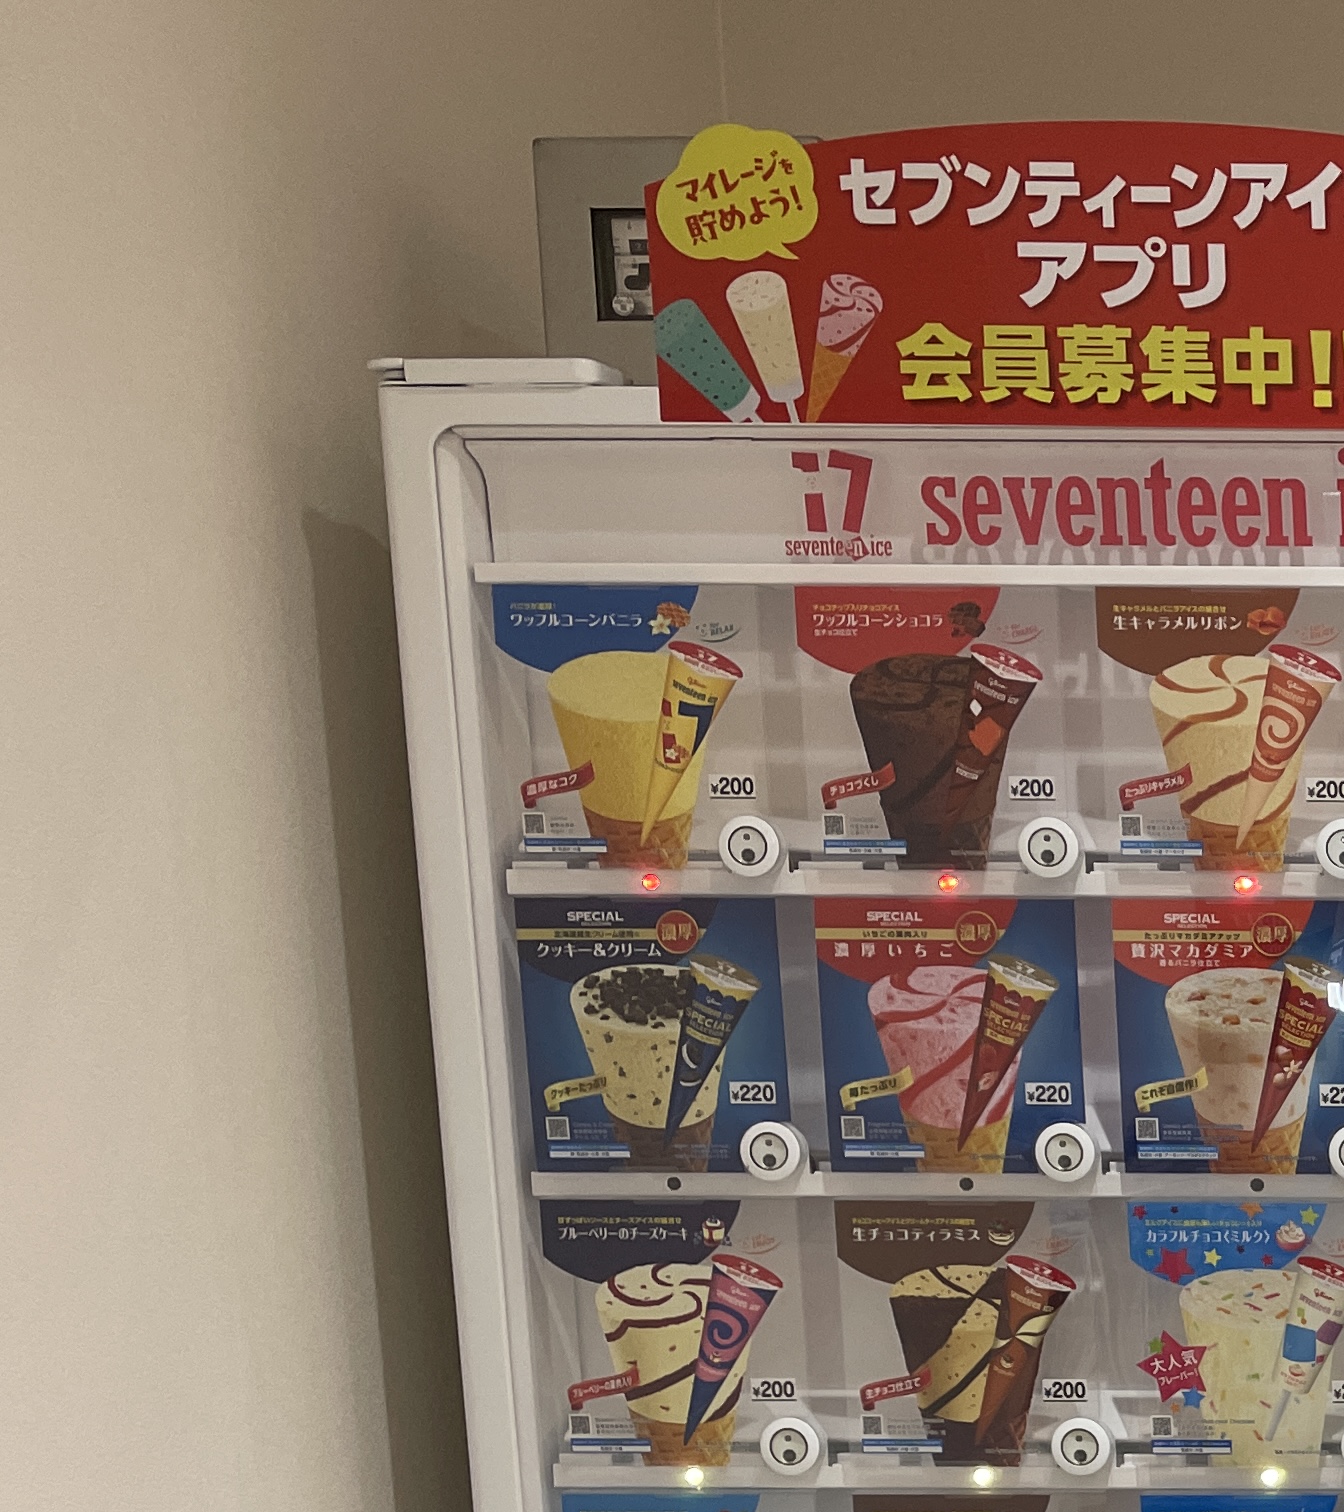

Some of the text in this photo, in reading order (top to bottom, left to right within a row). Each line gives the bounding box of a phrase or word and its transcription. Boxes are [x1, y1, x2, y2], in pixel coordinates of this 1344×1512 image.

[674, 157, 796, 207] マイレージを
[1017, 238, 1228, 308] アプリ
[921, 458, 1314, 549] seventeen
[510, 613, 643, 629] ワッフルコーンバニラ
[813, 613, 943, 629] ワッフルコーンショコラ
[1114, 615, 1242, 631] 生キャラメルリボン
[710, 777, 754, 797] ¥200
[1011, 778, 1054, 798] ¥200
[567, 912, 623, 922] SPECIAL
[866, 912, 922, 922] SPECIAL
[1164, 914, 1220, 924] SPECIAL
[834, 942, 953, 958] 濃厚いちご
[731, 1084, 774, 1102] ¥220
[1028, 1085, 1069, 1103] ¥220
[558, 1227, 688, 1241] ブルーベリーのチーズケーキ
[852, 1227, 981, 1242] 生チョコティラミス
[1150, 1349, 1199, 1374] 大人気
[753, 1381, 795, 1398] ¥200
[1044, 1382, 1086, 1399] ¥200
